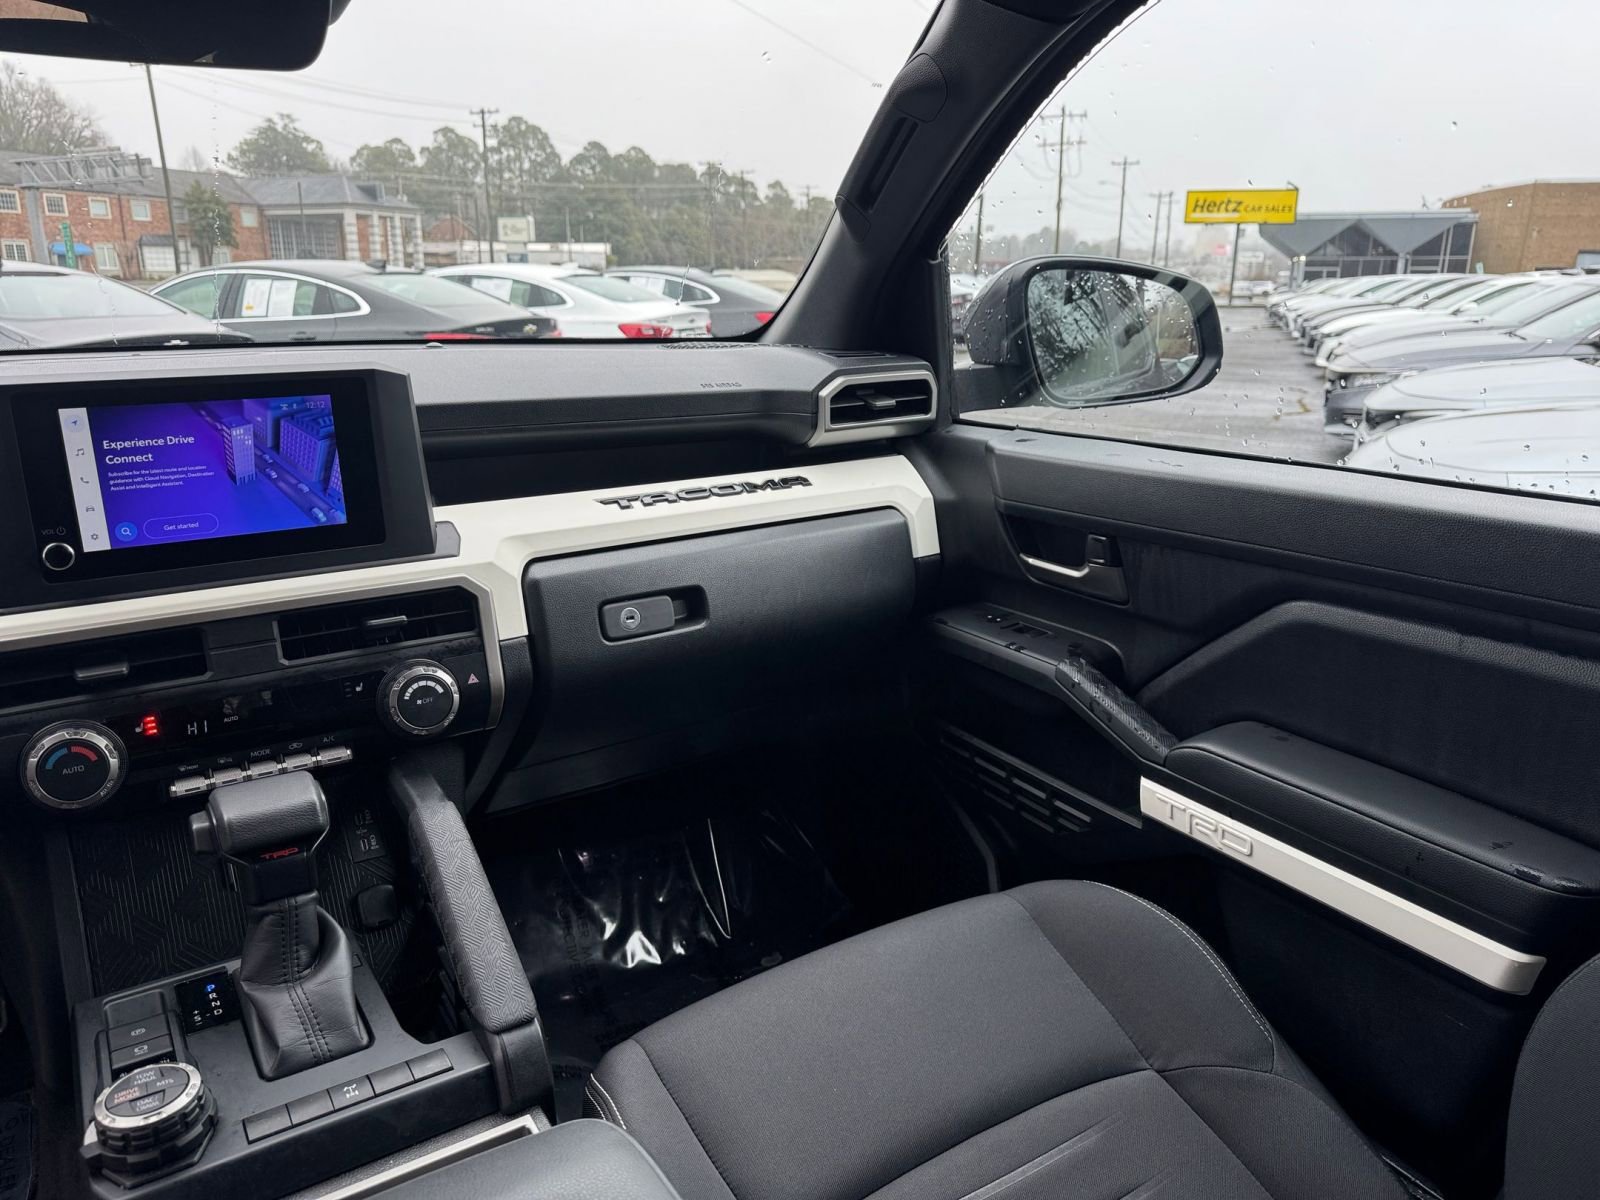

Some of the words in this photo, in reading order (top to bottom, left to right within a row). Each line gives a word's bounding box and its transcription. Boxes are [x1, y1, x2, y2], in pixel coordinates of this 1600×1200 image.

[1192, 196, 1243, 214] Hertz
[1243, 204, 1263, 213] CAR
[1264, 204, 1293, 213] SALES
[103, 437, 165, 450] Experience
[166, 435, 195, 445] Drive
[105, 453, 154, 465] Connect
[108, 470, 133, 478] Subscribe
[109, 477, 133, 485] guidance
[592, 475, 813, 510] TACOMA
[177, 522, 199, 530] started
[223, 715, 239, 723] AUTO
[187, 720, 208, 736] HI
[250, 749, 271, 758] MODE
[62, 764, 85, 776] AUTO
[1155, 793, 1254, 857] TRD
[260, 847, 299, 859] TRD
[206, 983, 216, 992] P
[214, 1008, 223, 1016] D
[156, 1078, 174, 1087] MTS
